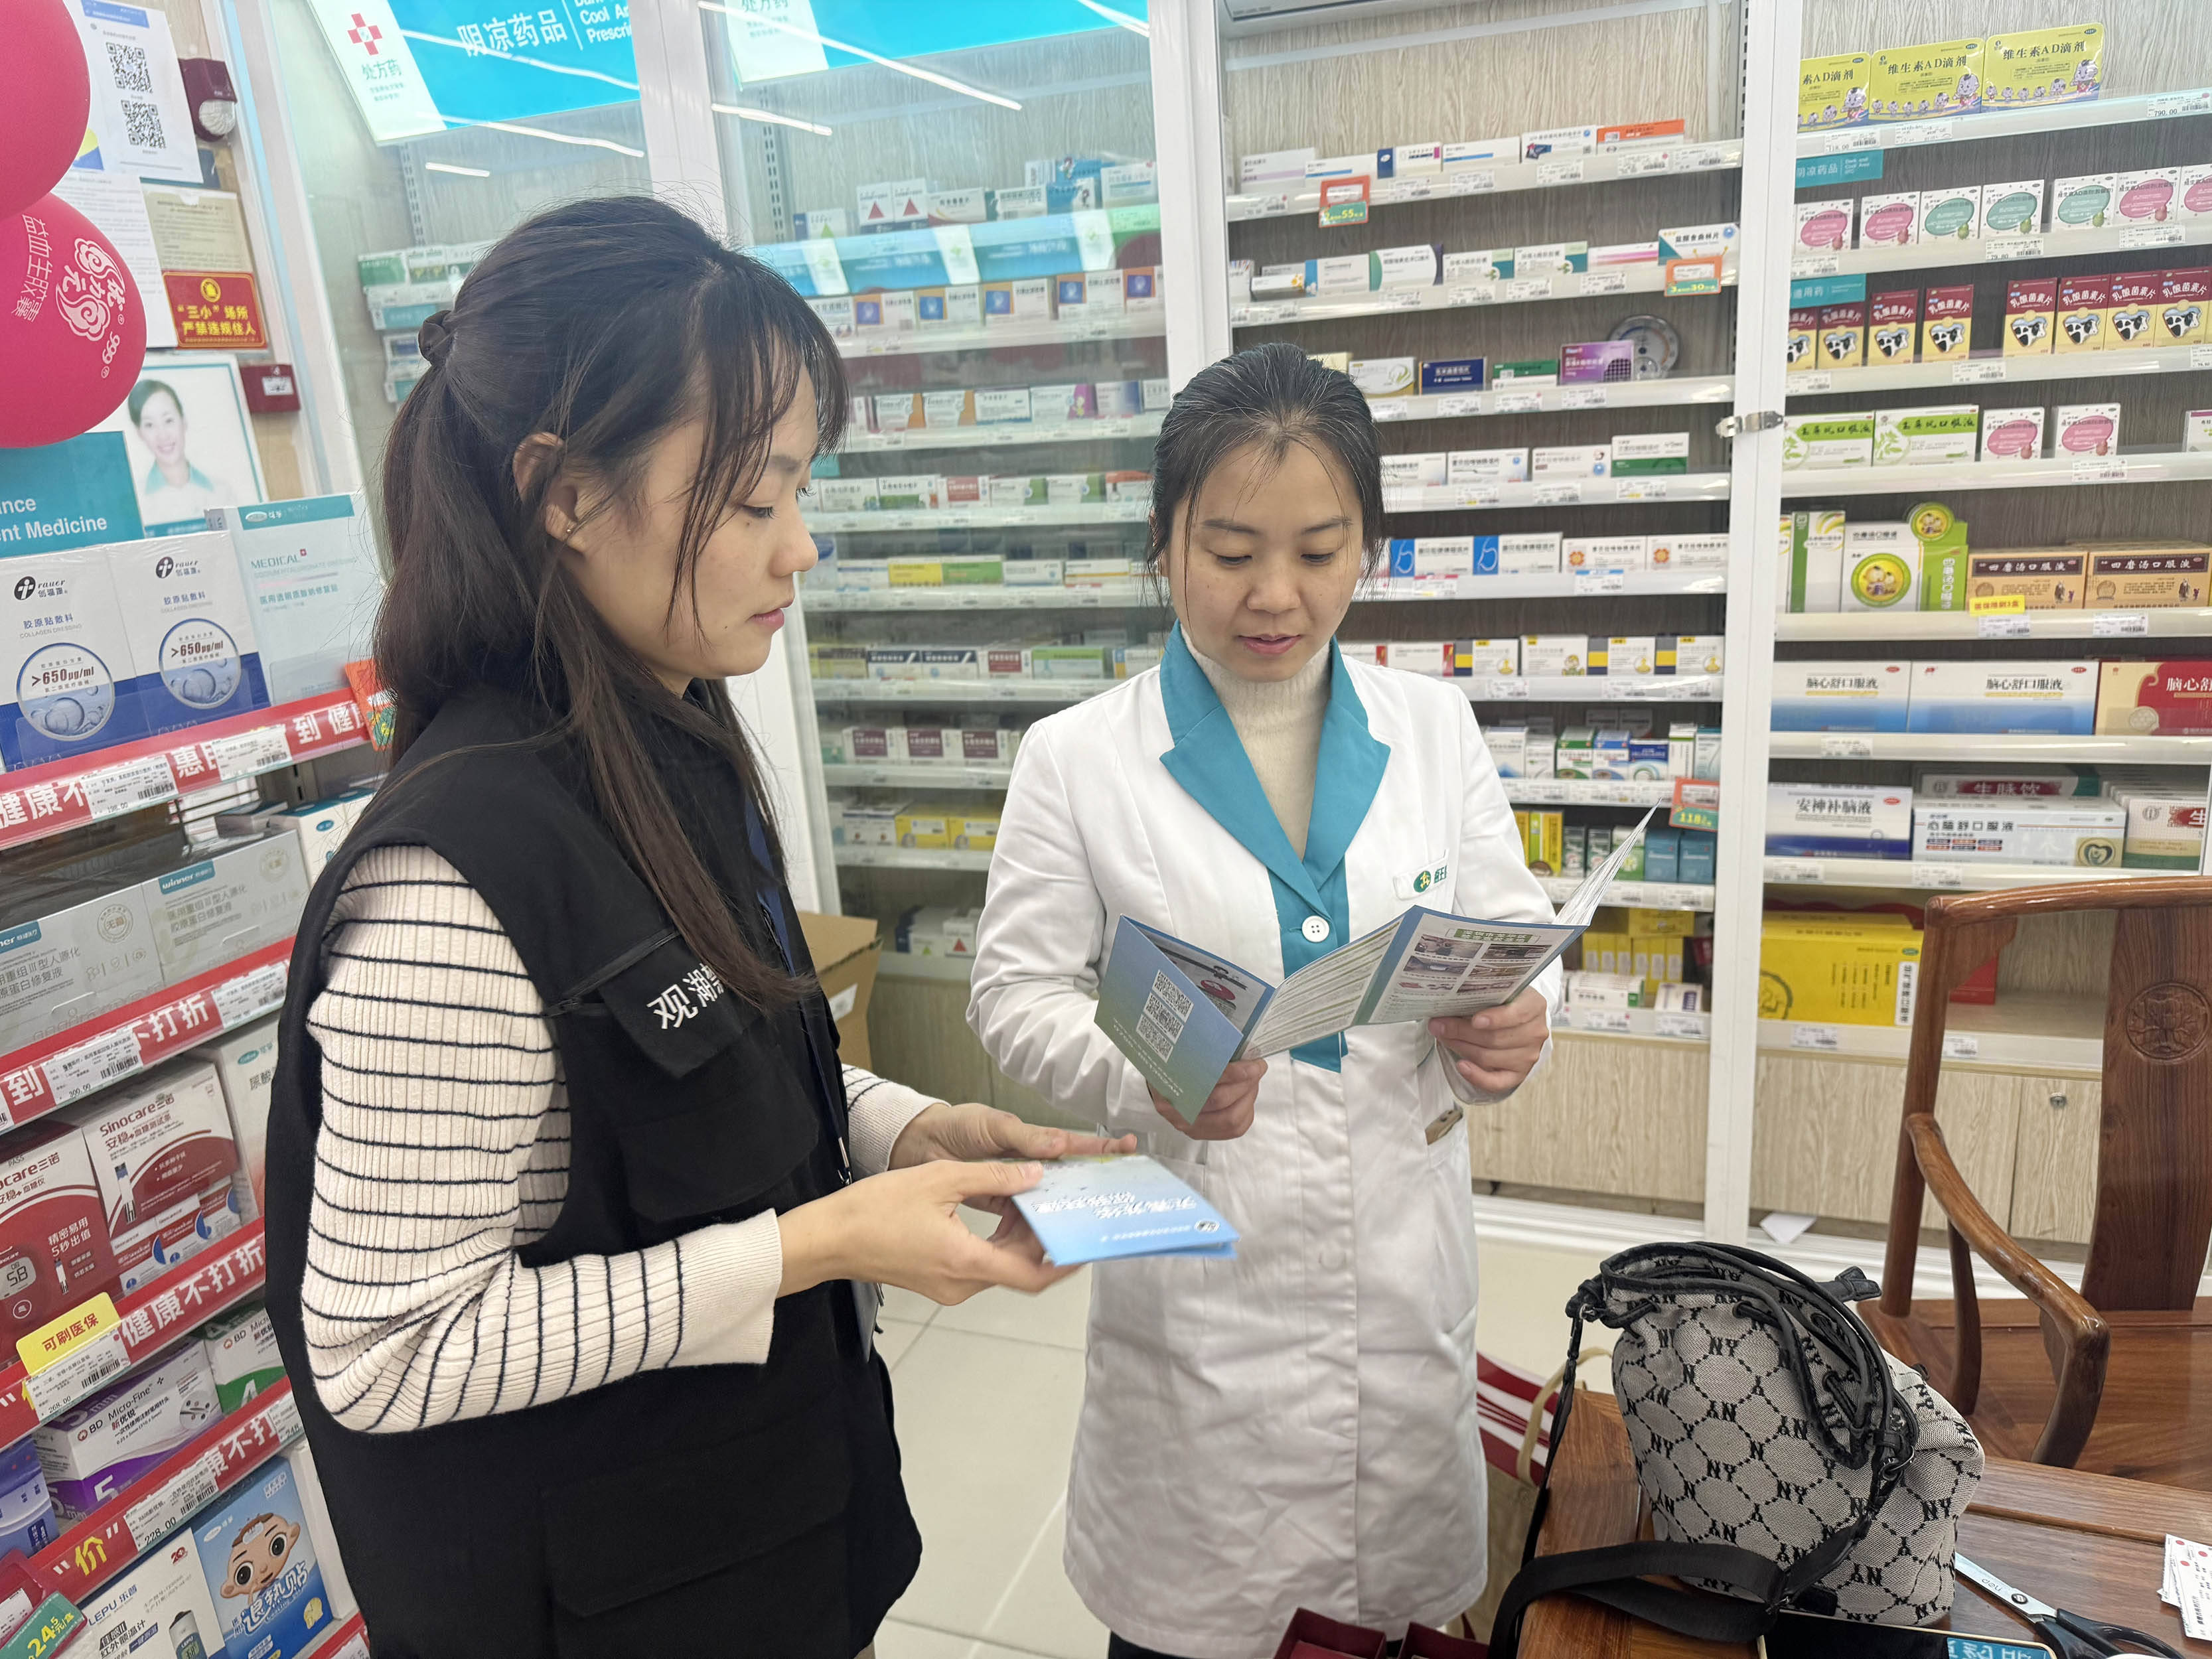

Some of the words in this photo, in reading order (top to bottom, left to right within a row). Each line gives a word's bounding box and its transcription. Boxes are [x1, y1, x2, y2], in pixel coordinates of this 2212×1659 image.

[579, 5, 611, 25] Cool
[457, 9, 569, 58] 阴凉药品
[2002, 40, 2085, 60] 维生素AD滴剂
[362, 58, 402, 80] 处方药
[1888, 54, 1968, 75] 维生素AD滴剂
[11, 214, 52, 323] 益血生胶囊
[181, 321, 256, 336] 严禁违规住人
[102, 331, 121, 365] 999
[25, 516, 108, 540] Medicine
[251, 554, 301, 569] MEDICAL
[163, 591, 206, 606] 胶原贴敷料
[23, 613, 74, 630] 胶原贴敷料
[1806, 677, 1879, 691] 脑心舒口服液
[1986, 677, 2064, 692] 脑心舒口服液
[293, 717, 322, 745] 到
[1795, 799, 1872, 816] 安神补脑液
[161, 873, 194, 890] winner
[4, 1064, 45, 1106] 到
[99, 1101, 157, 1137] Sinocare
[37, 1152, 61, 1173] 三诺
[23, 1178, 46, 1194] 血糖仪
[47, 1216, 90, 1246] 精密易用
[51, 1230, 92, 1258] 5秒出值
[119, 1238, 265, 1350] 健康不打折
[42, 1313, 100, 1352] 可刷医保
[234, 1330, 247, 1342] BD
[48, 1396, 72, 1414] 268.00
[89, 1419, 104, 1434] BD
[1924, 1498, 1952, 1522] NY
[144, 1516, 177, 1546] 228.00
[52, 1522, 119, 1577] “价”
[88, 1599, 117, 1626] LEPU
[119, 1583, 138, 1603] 乐普
[240, 1560, 308, 1636] 退热贴
